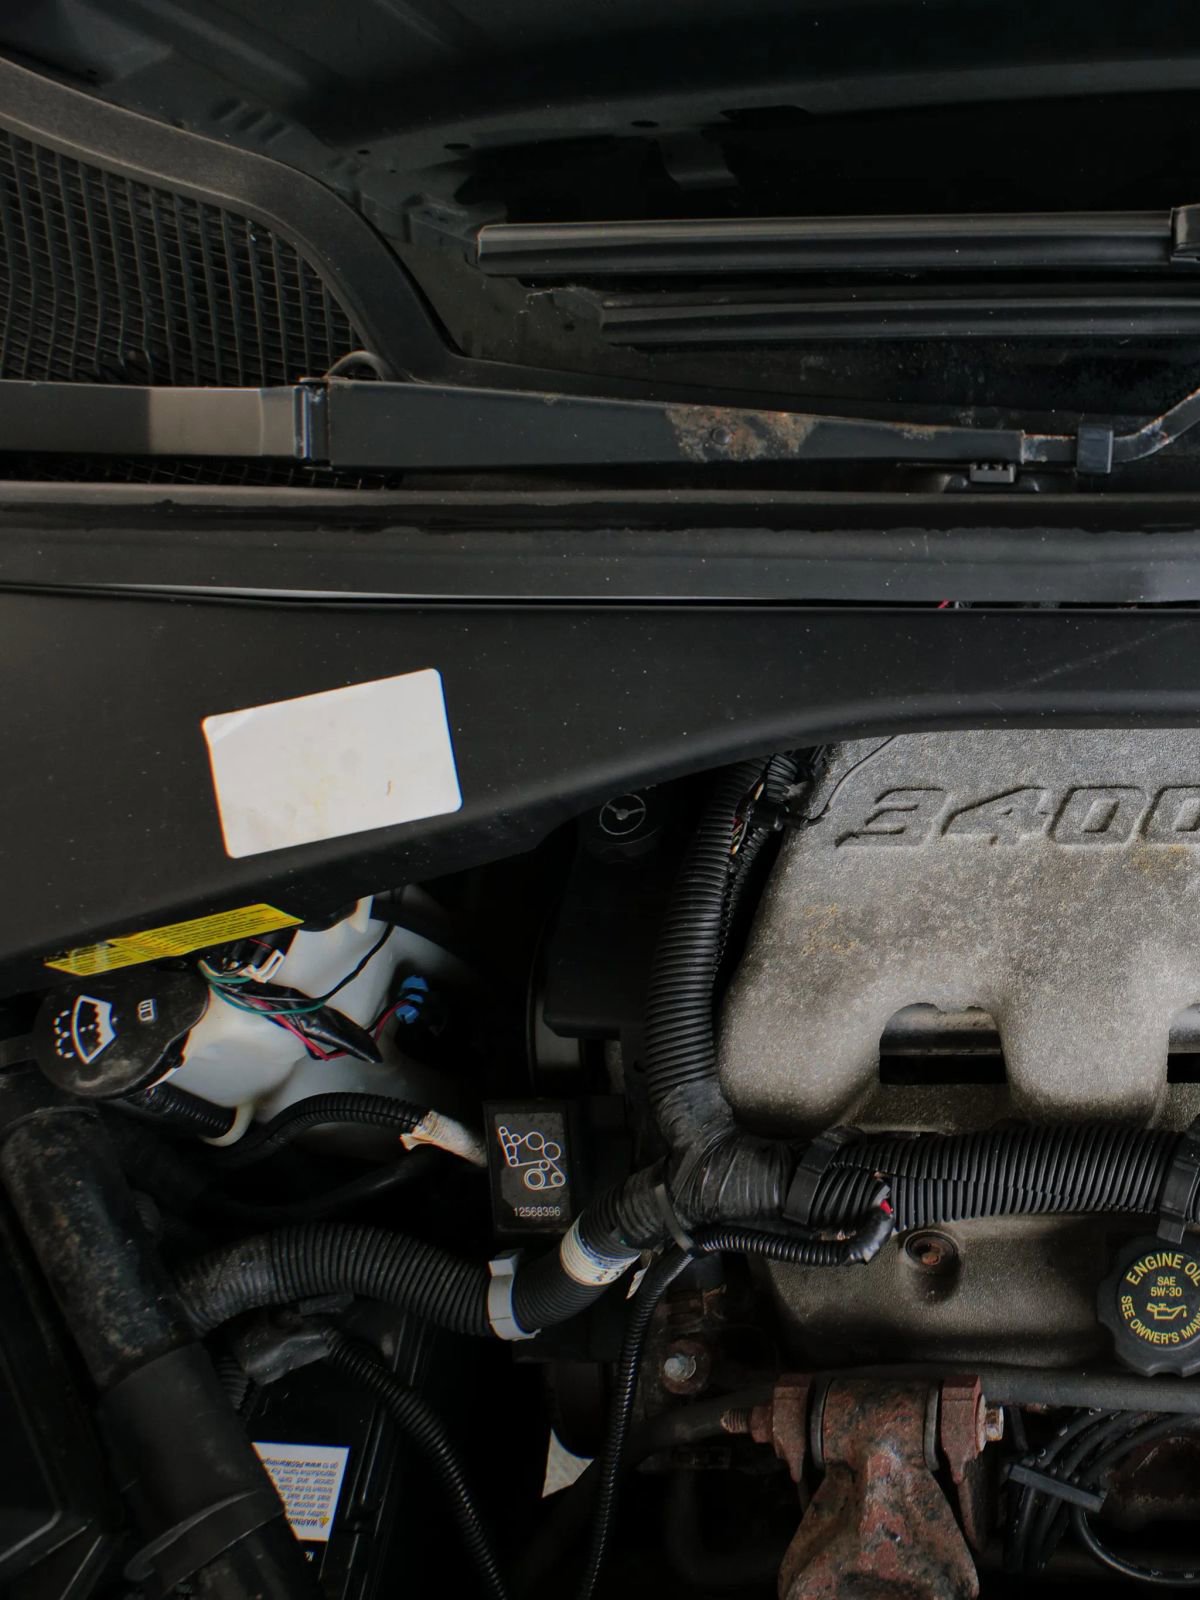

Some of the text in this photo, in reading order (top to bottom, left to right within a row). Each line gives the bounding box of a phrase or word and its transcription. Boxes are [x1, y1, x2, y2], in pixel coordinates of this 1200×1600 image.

[513, 1207, 561, 1217] 12568396
[1126, 1253, 1184, 1286] ENGINE
[1157, 1276, 1176, 1286] SAE
[1150, 1287, 1182, 1297] 5W-30
[1121, 1295, 1136, 1320] SEE
[1130, 1319, 1180, 1345] OWNER'S
